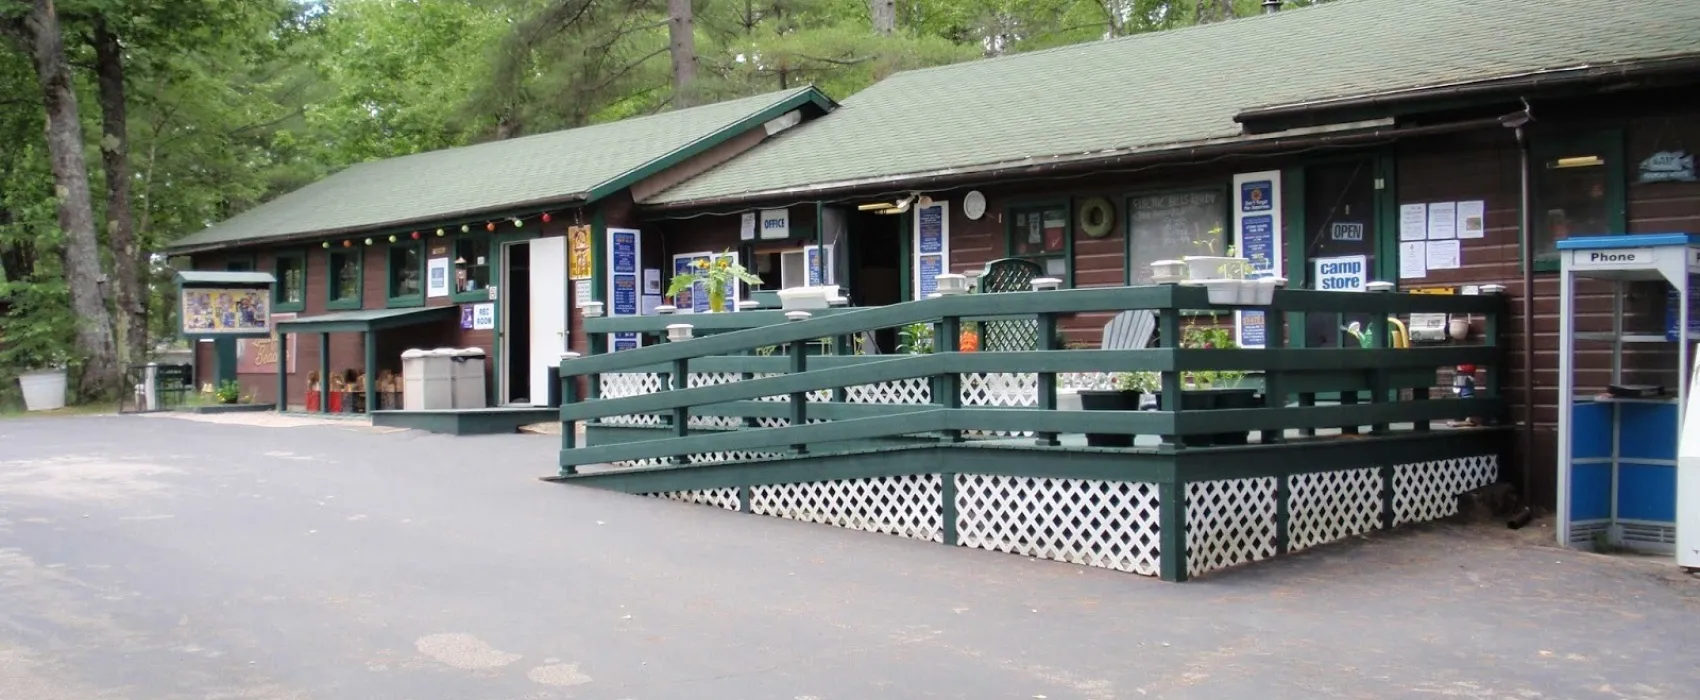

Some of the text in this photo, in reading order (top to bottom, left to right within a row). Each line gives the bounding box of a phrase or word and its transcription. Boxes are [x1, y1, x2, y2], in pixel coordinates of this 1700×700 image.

[764, 218, 785, 229] OFFICE
[1334, 224, 1361, 239] OPEN
[1590, 252, 1636, 262] Phone
[1320, 261, 1362, 275] camp
[1322, 276, 1360, 290] store
[479, 307, 490, 316] REC
[476, 317, 492, 325] ROOM
